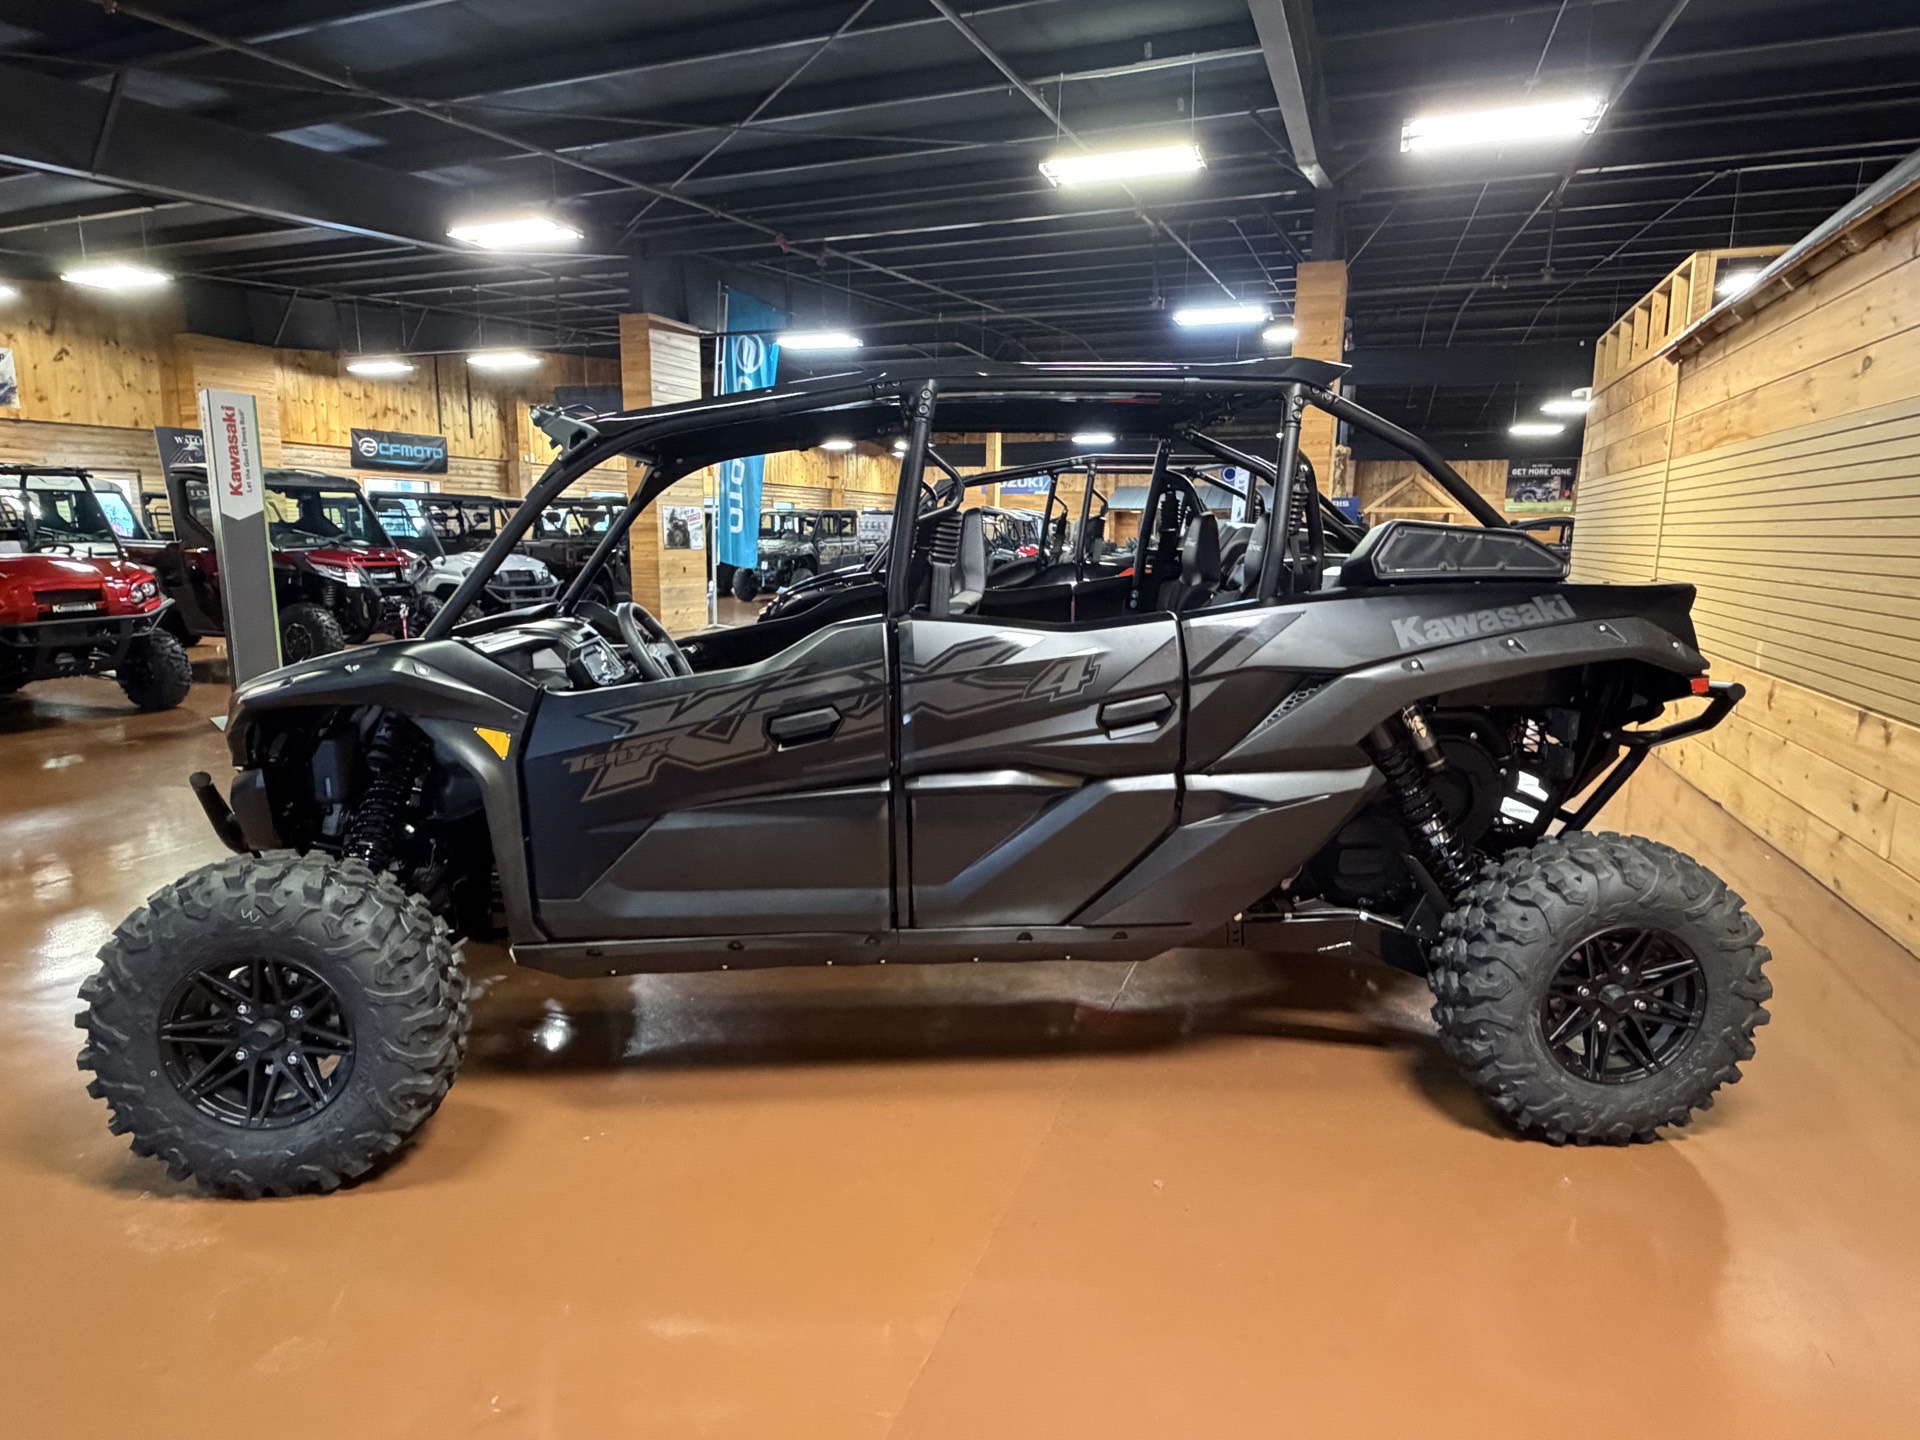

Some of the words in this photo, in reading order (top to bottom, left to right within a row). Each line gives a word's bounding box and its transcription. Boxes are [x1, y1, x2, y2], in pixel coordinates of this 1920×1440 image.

[241, 426, 249, 448] Times
[221, 405, 243, 496] Kawasaki
[379, 443, 444, 459] CFMOTO
[1511, 468, 1527, 476] GET
[1528, 468, 1549, 476] MORE
[1550, 468, 1572, 476] DONE
[1391, 593, 1577, 649] Kawasaki
